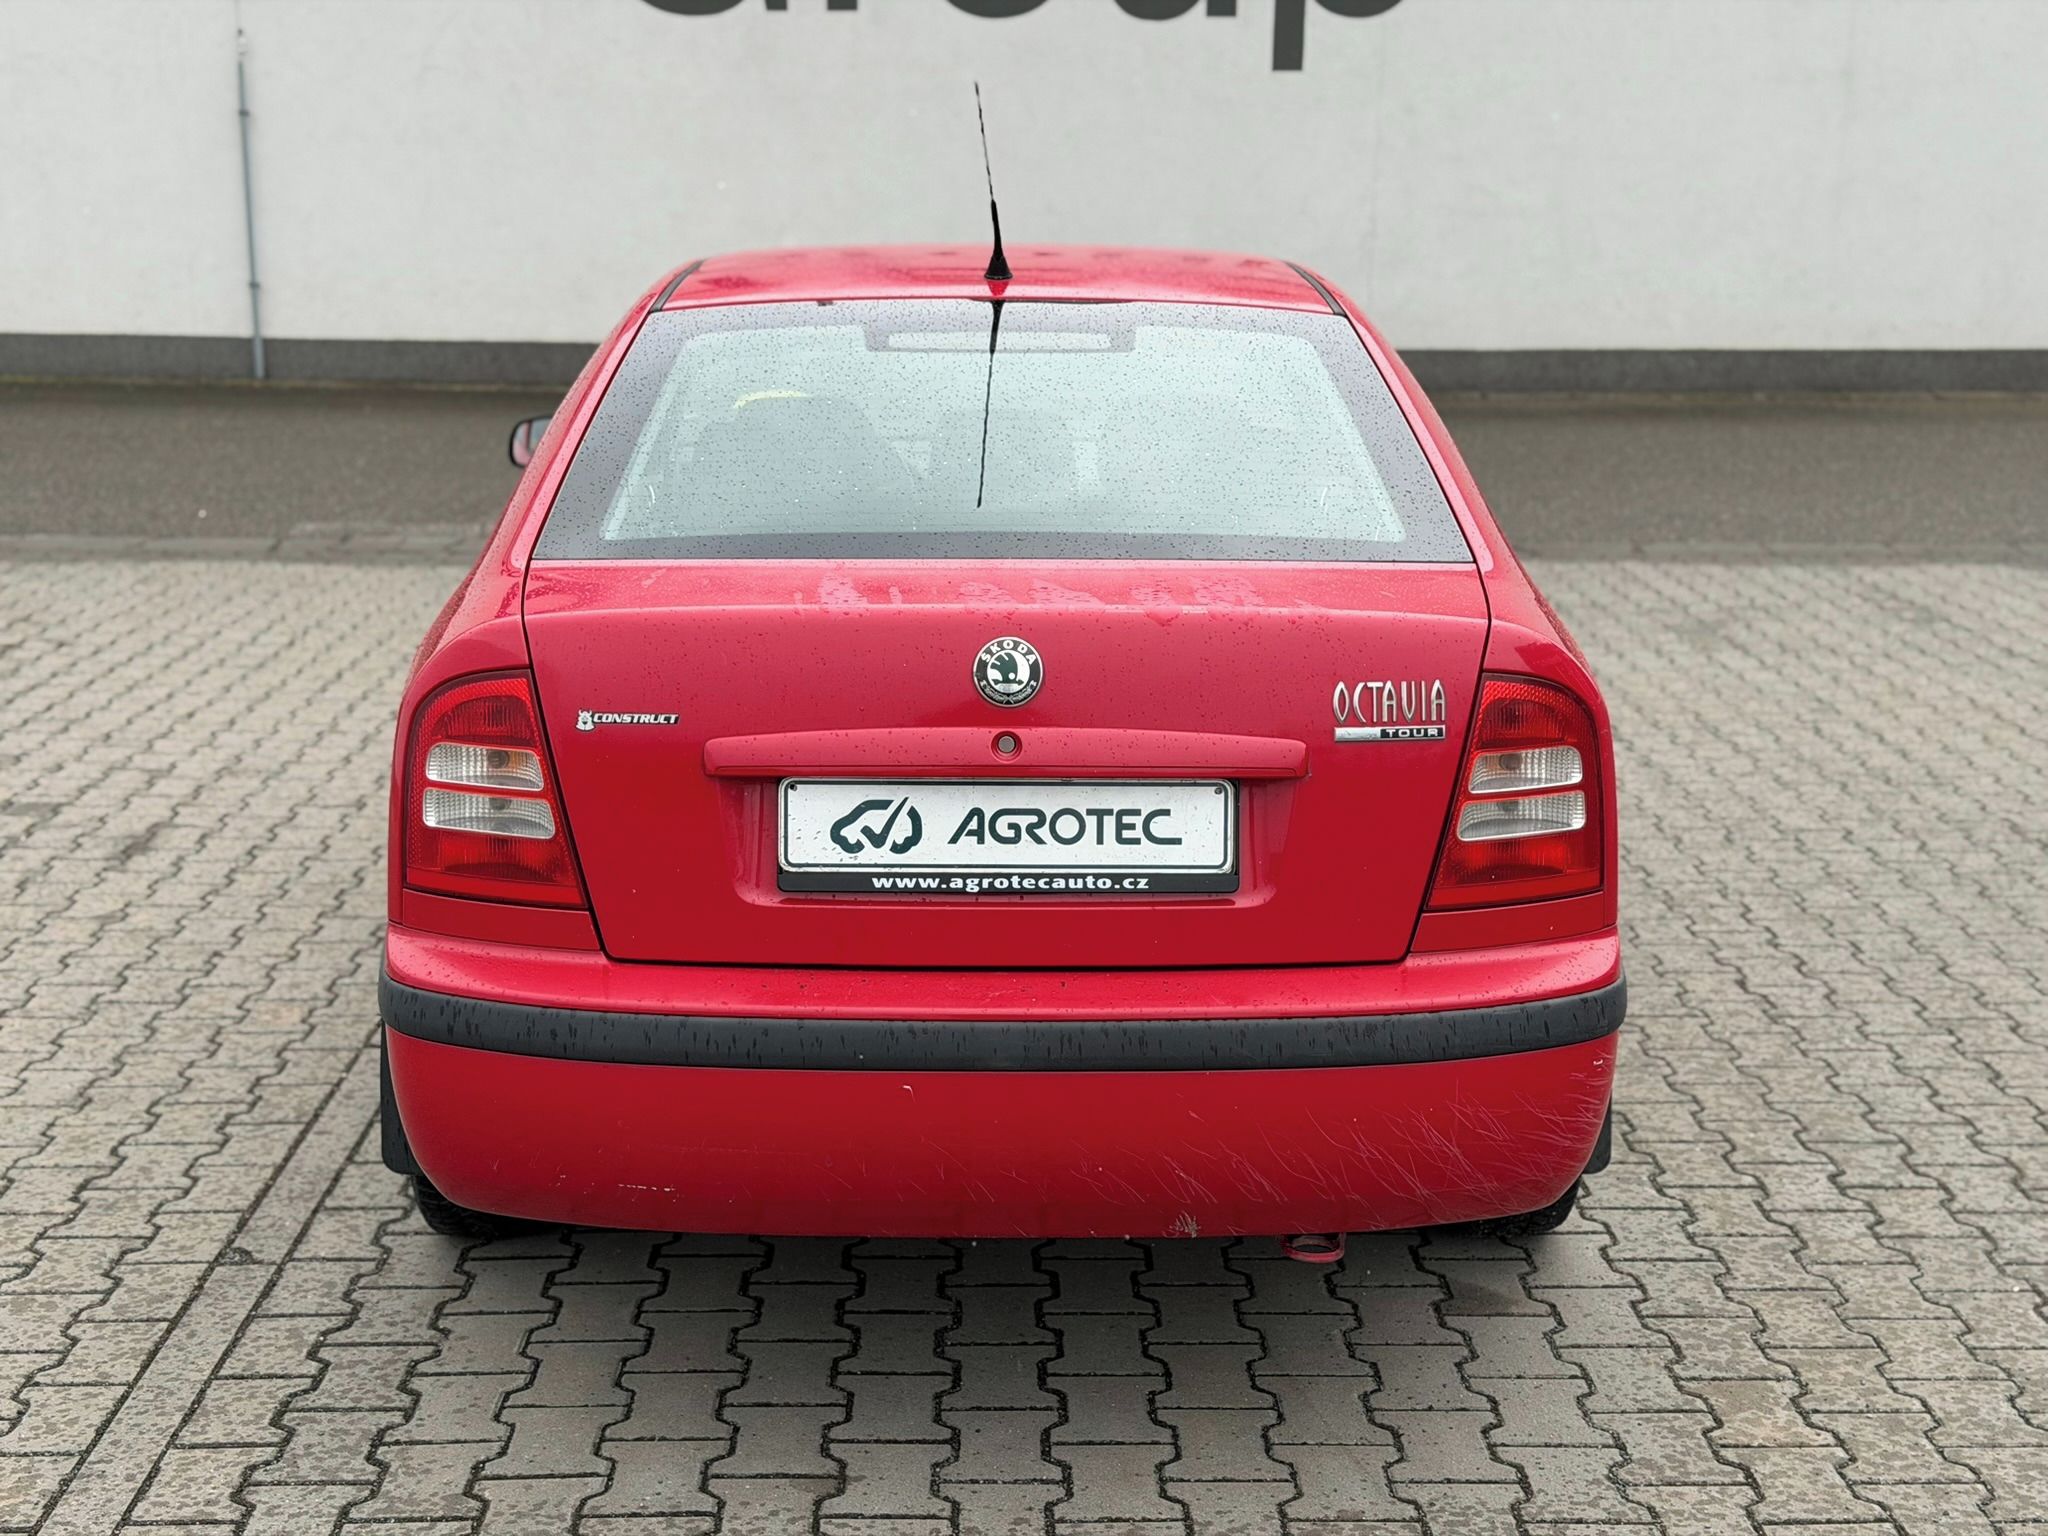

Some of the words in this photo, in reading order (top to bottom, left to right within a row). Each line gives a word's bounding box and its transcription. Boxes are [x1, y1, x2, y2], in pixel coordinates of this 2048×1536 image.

[1333, 679, 1446, 724] OCTAVIA
[593, 713, 679, 724] CONSTRUCT
[1386, 728, 1439, 738] TOUR
[947, 807, 1183, 846] AGROTEC
[871, 874, 1150, 893] www.agrotecauto.cz
